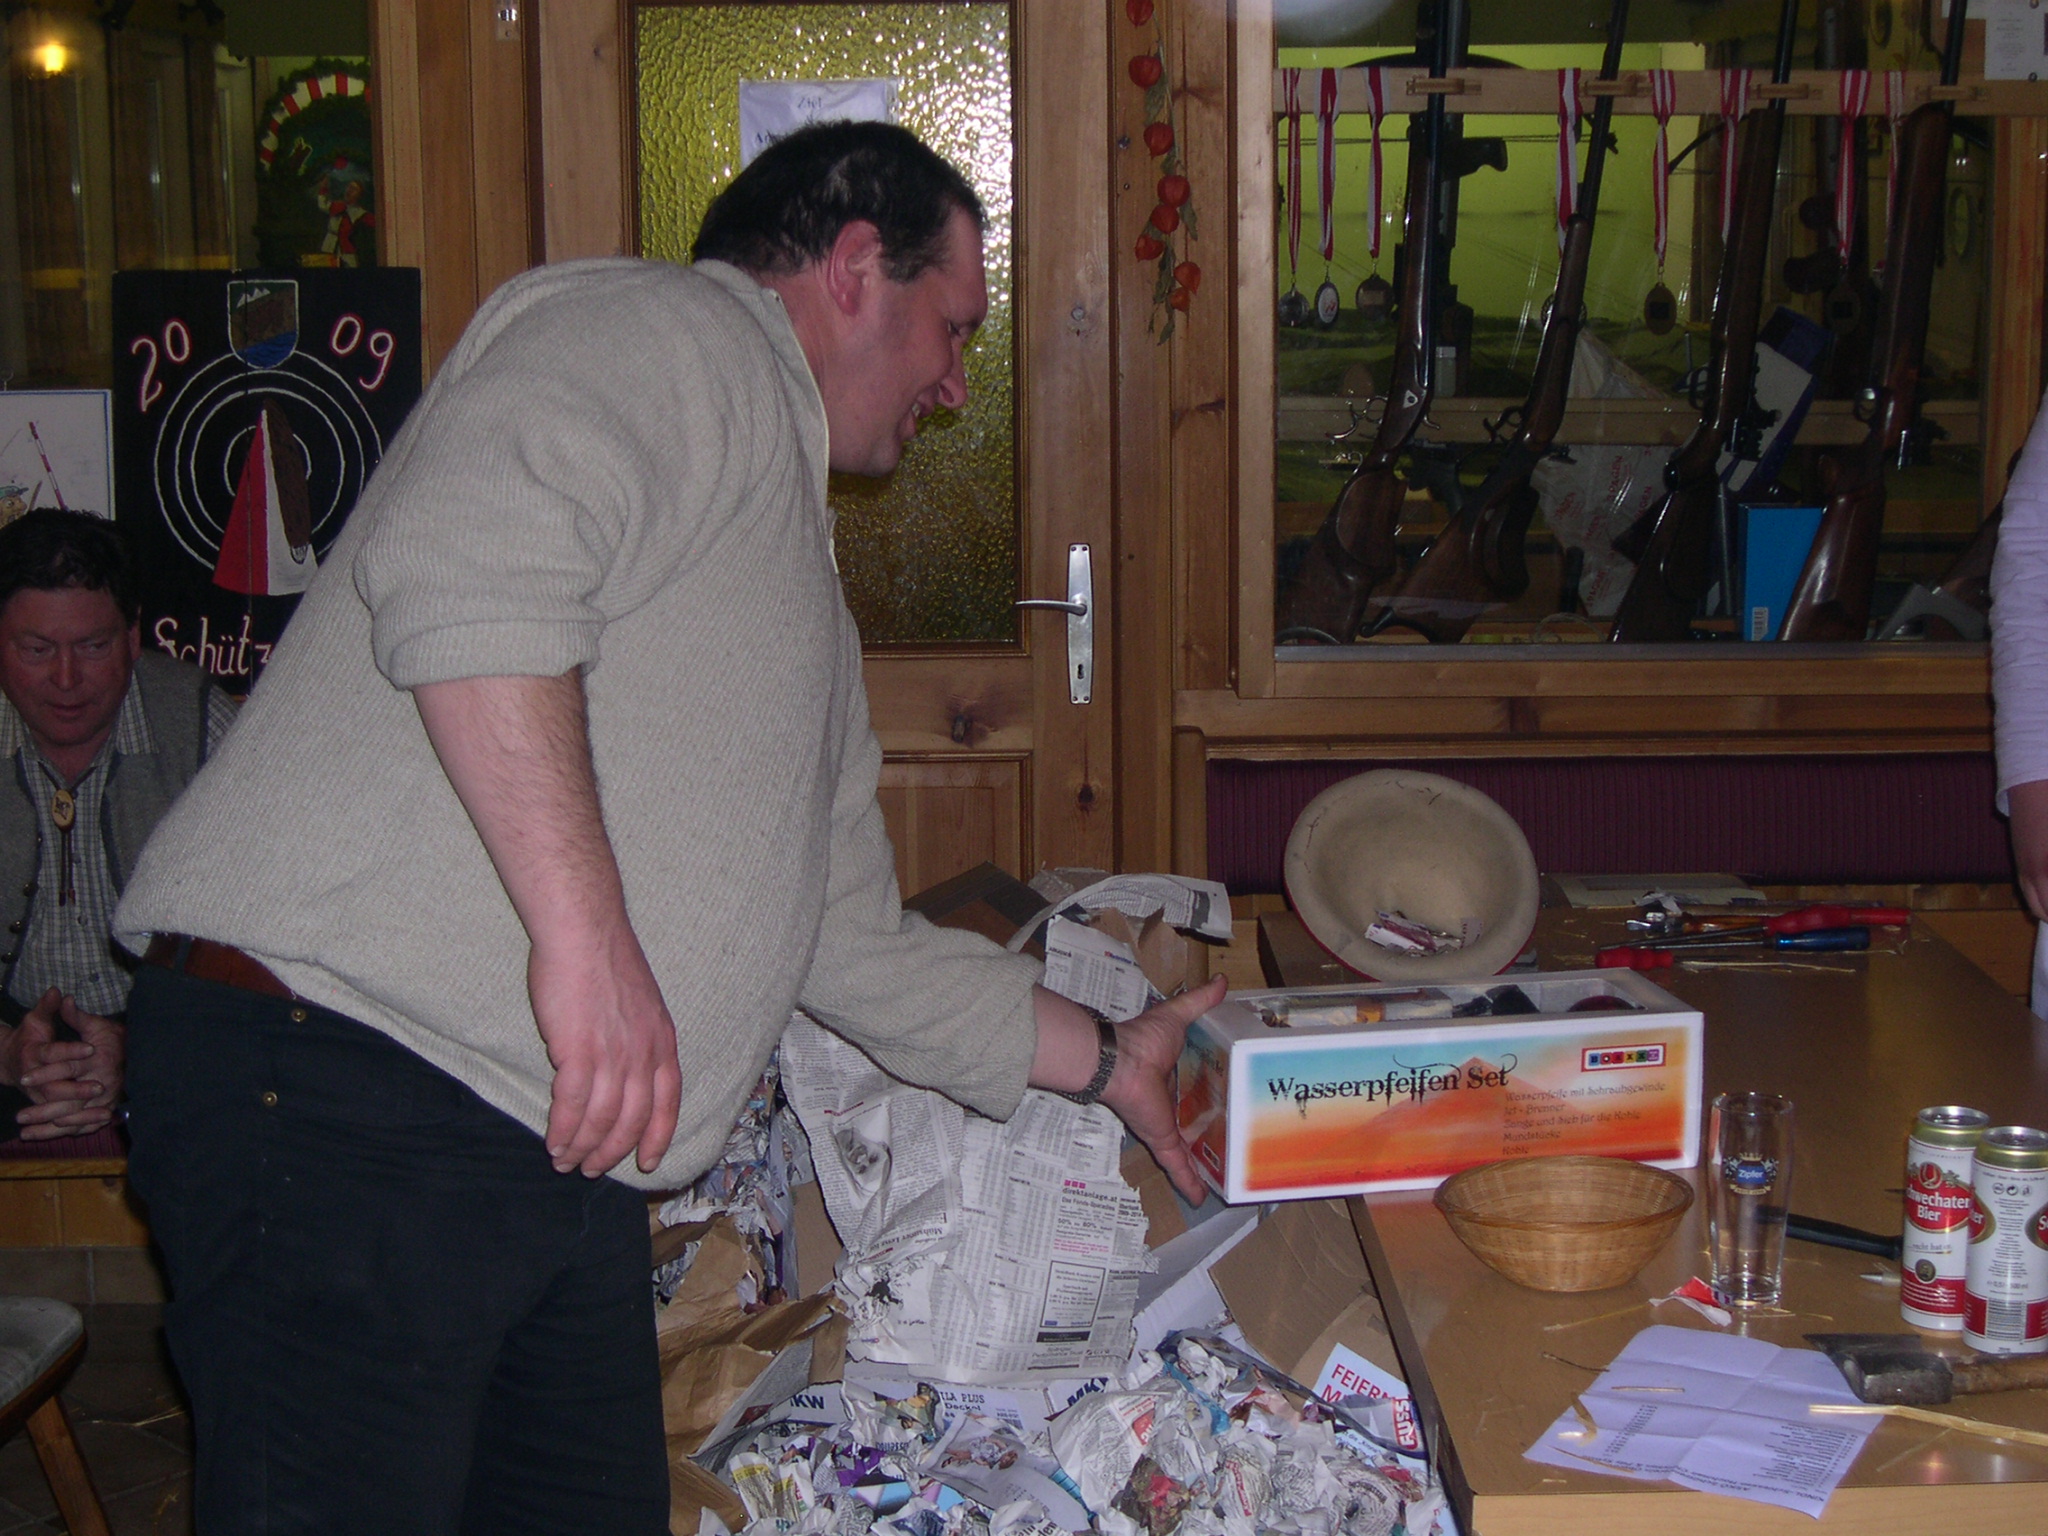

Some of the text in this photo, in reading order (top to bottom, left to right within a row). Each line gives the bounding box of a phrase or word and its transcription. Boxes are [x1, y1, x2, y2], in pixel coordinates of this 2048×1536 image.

[1267, 1053, 1518, 1112] Wasserpfeifen Set
[1570, 1088, 1585, 1098] mit
[1526, 1104, 1566, 1114] Brenner
[1536, 1117, 1556, 1126] und
[1580, 1114, 1594, 1125] für
[1597, 1112, 1612, 1122] die
[1918, 1205, 1941, 1221] Bier
[961, 1393, 985, 1404] PLUS
